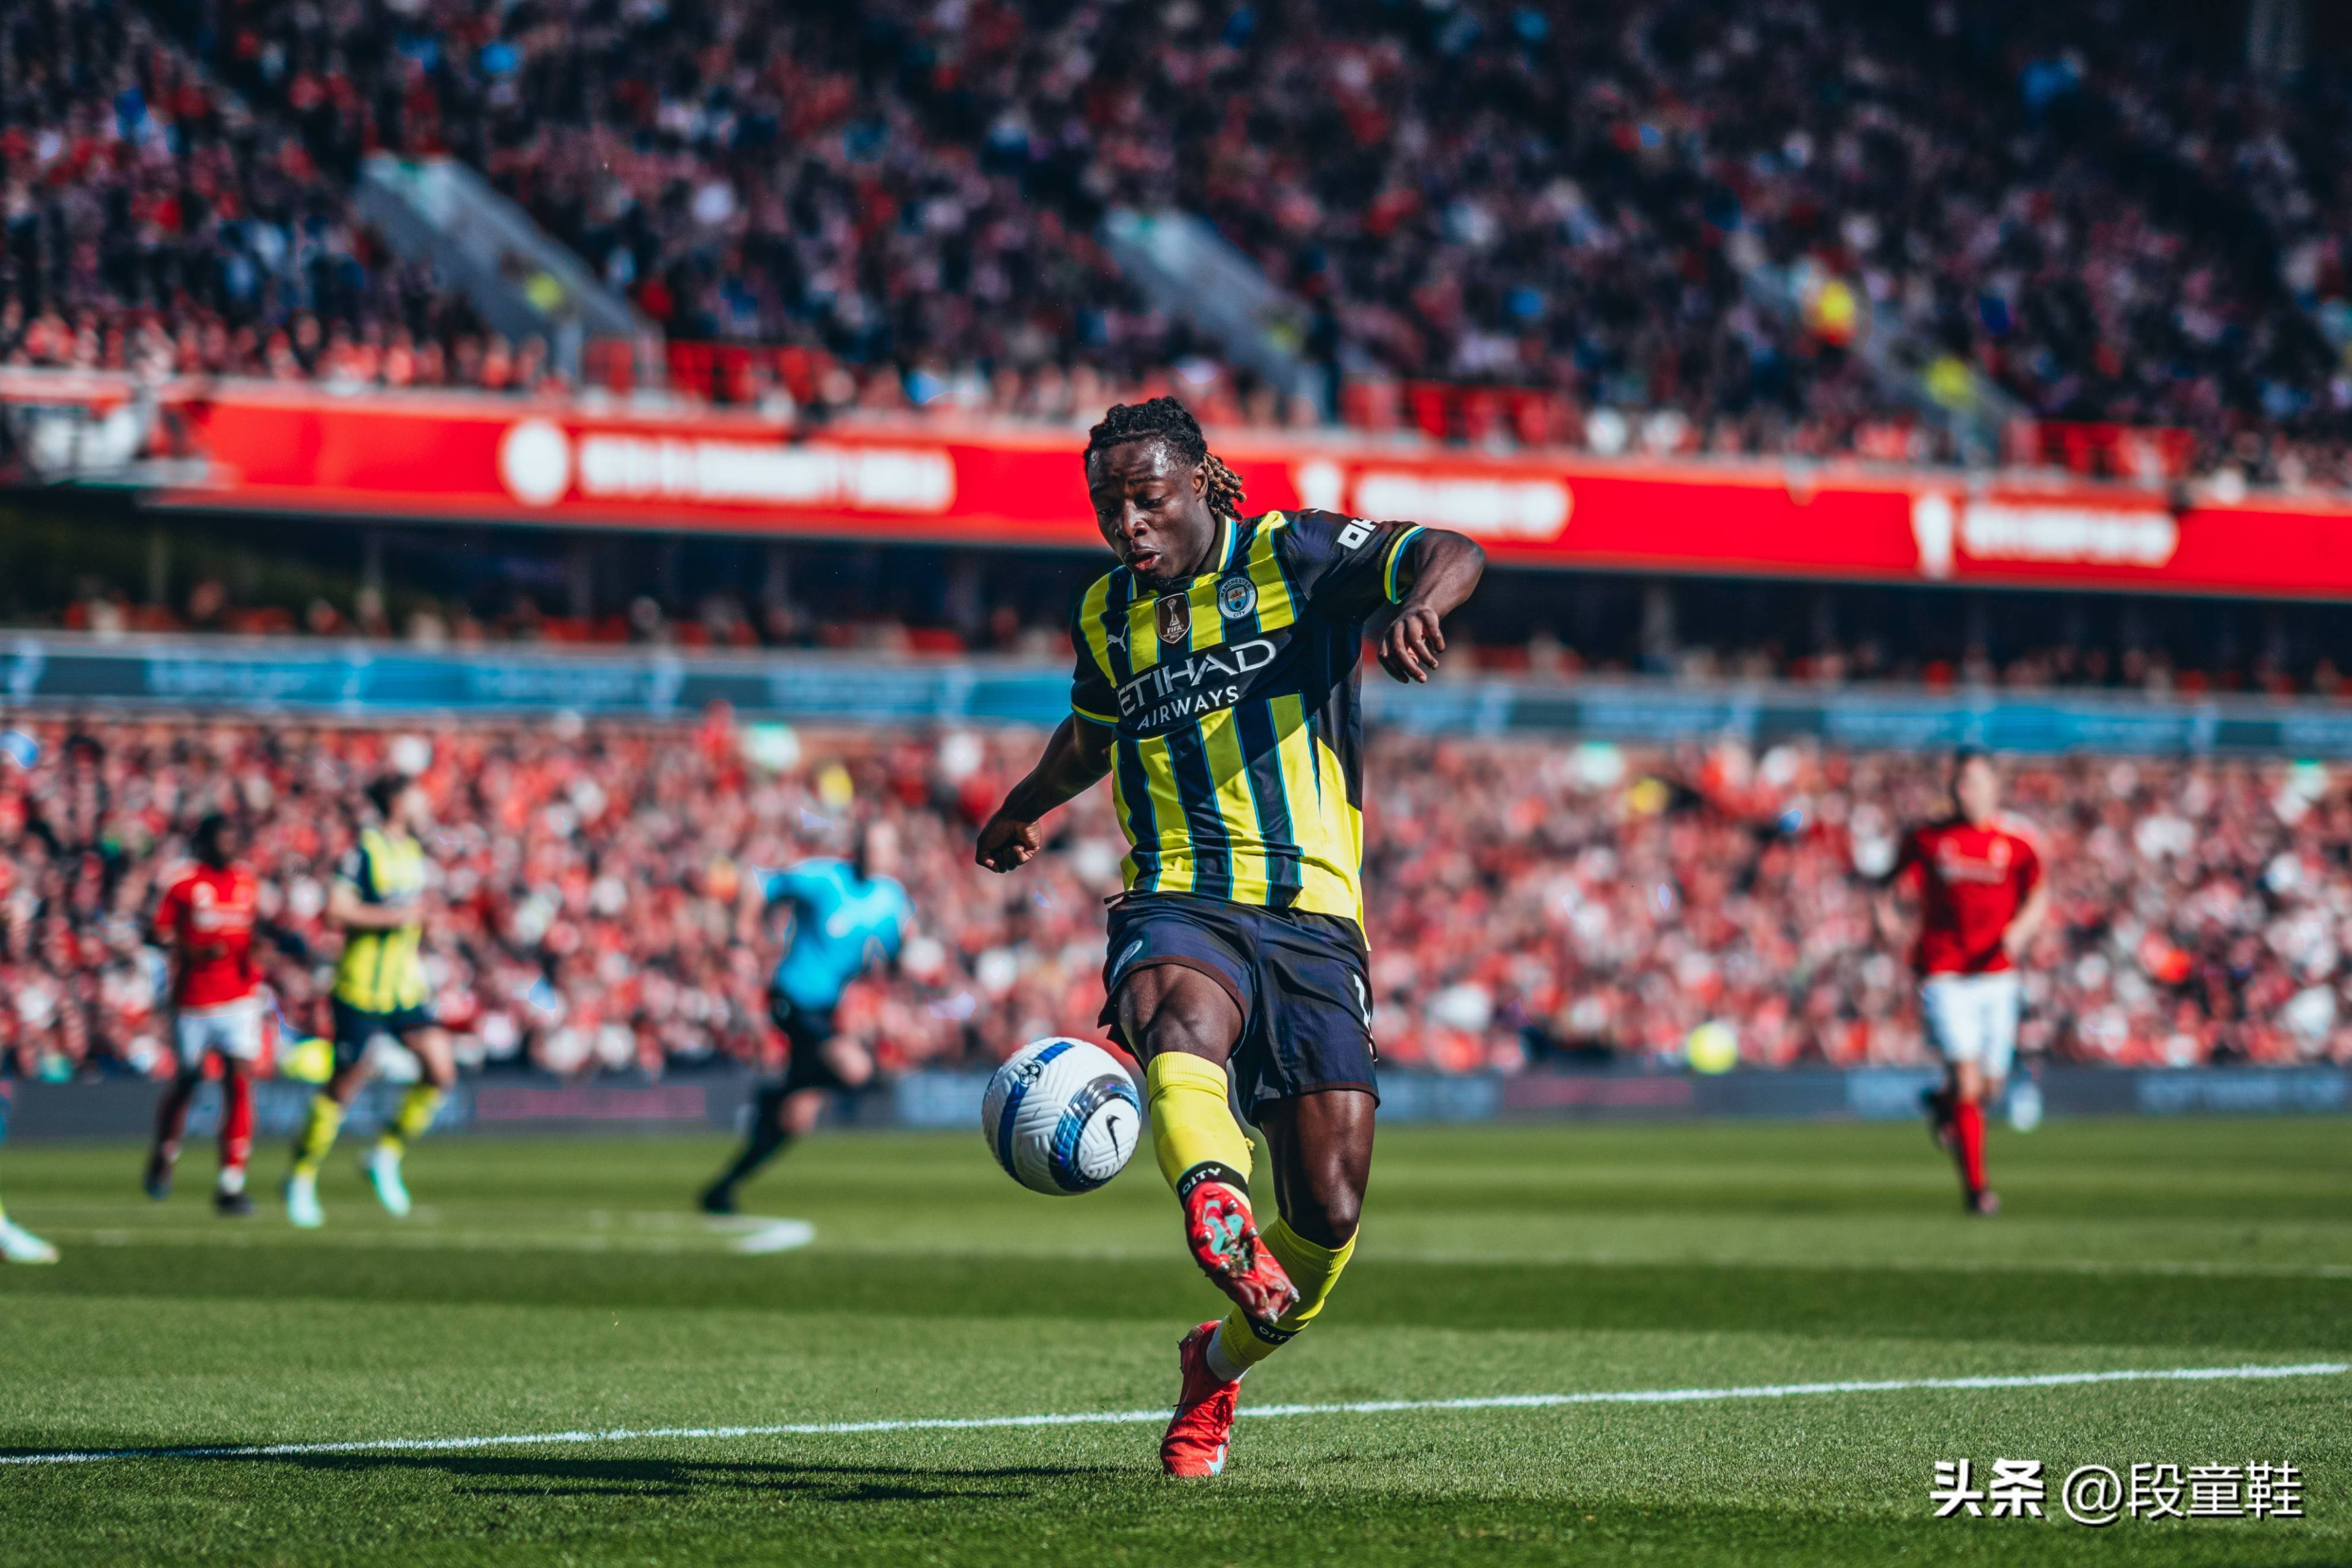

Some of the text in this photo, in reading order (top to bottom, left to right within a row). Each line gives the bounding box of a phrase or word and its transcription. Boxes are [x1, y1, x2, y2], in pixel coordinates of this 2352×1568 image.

[1221, 578, 1252, 598] MANCHESTER
[1167, 624, 1182, 634] FIFA
[1118, 639, 1276, 716] ETIHAD
[1137, 685, 1239, 731] AIRWAYS
[1182, 1167, 1221, 1195] CITY
